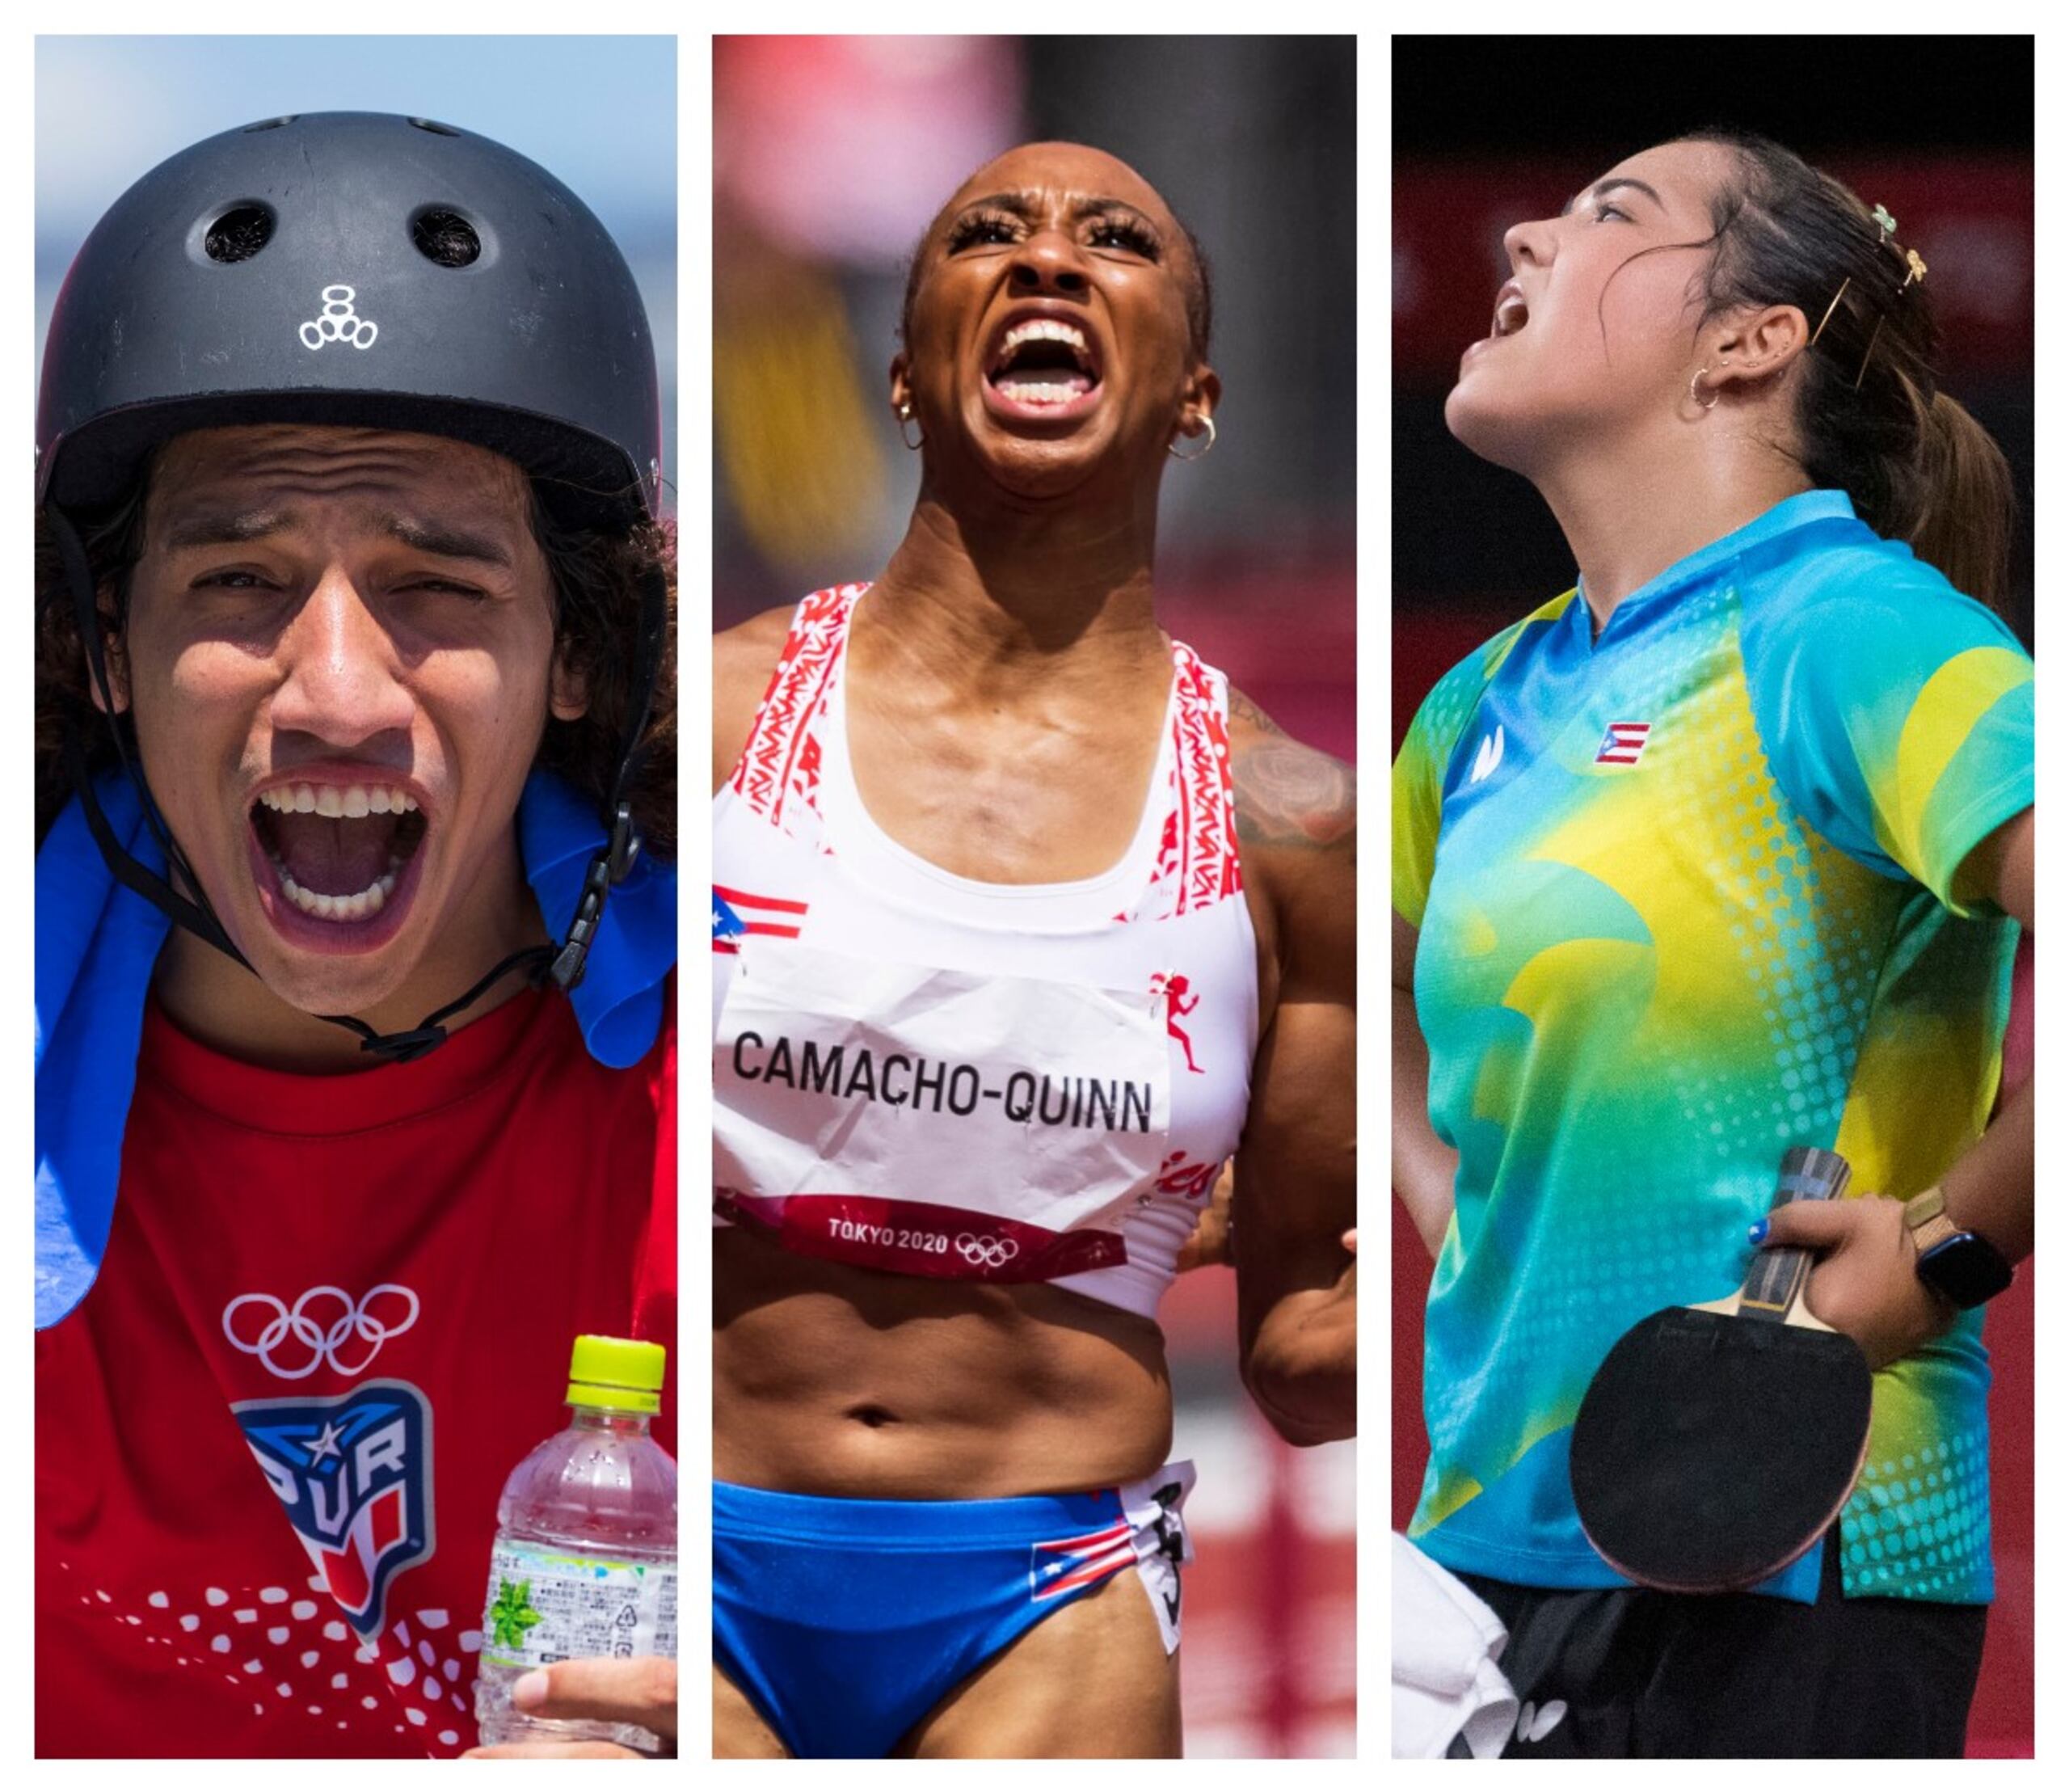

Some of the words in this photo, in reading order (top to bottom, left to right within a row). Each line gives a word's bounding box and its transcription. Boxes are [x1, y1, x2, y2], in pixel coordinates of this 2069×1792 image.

[733, 1031, 1151, 1133] CAMACHO-QUINN
[829, 1218, 894, 1246] TOKYO
[898, 1230, 948, 1253] 2020
